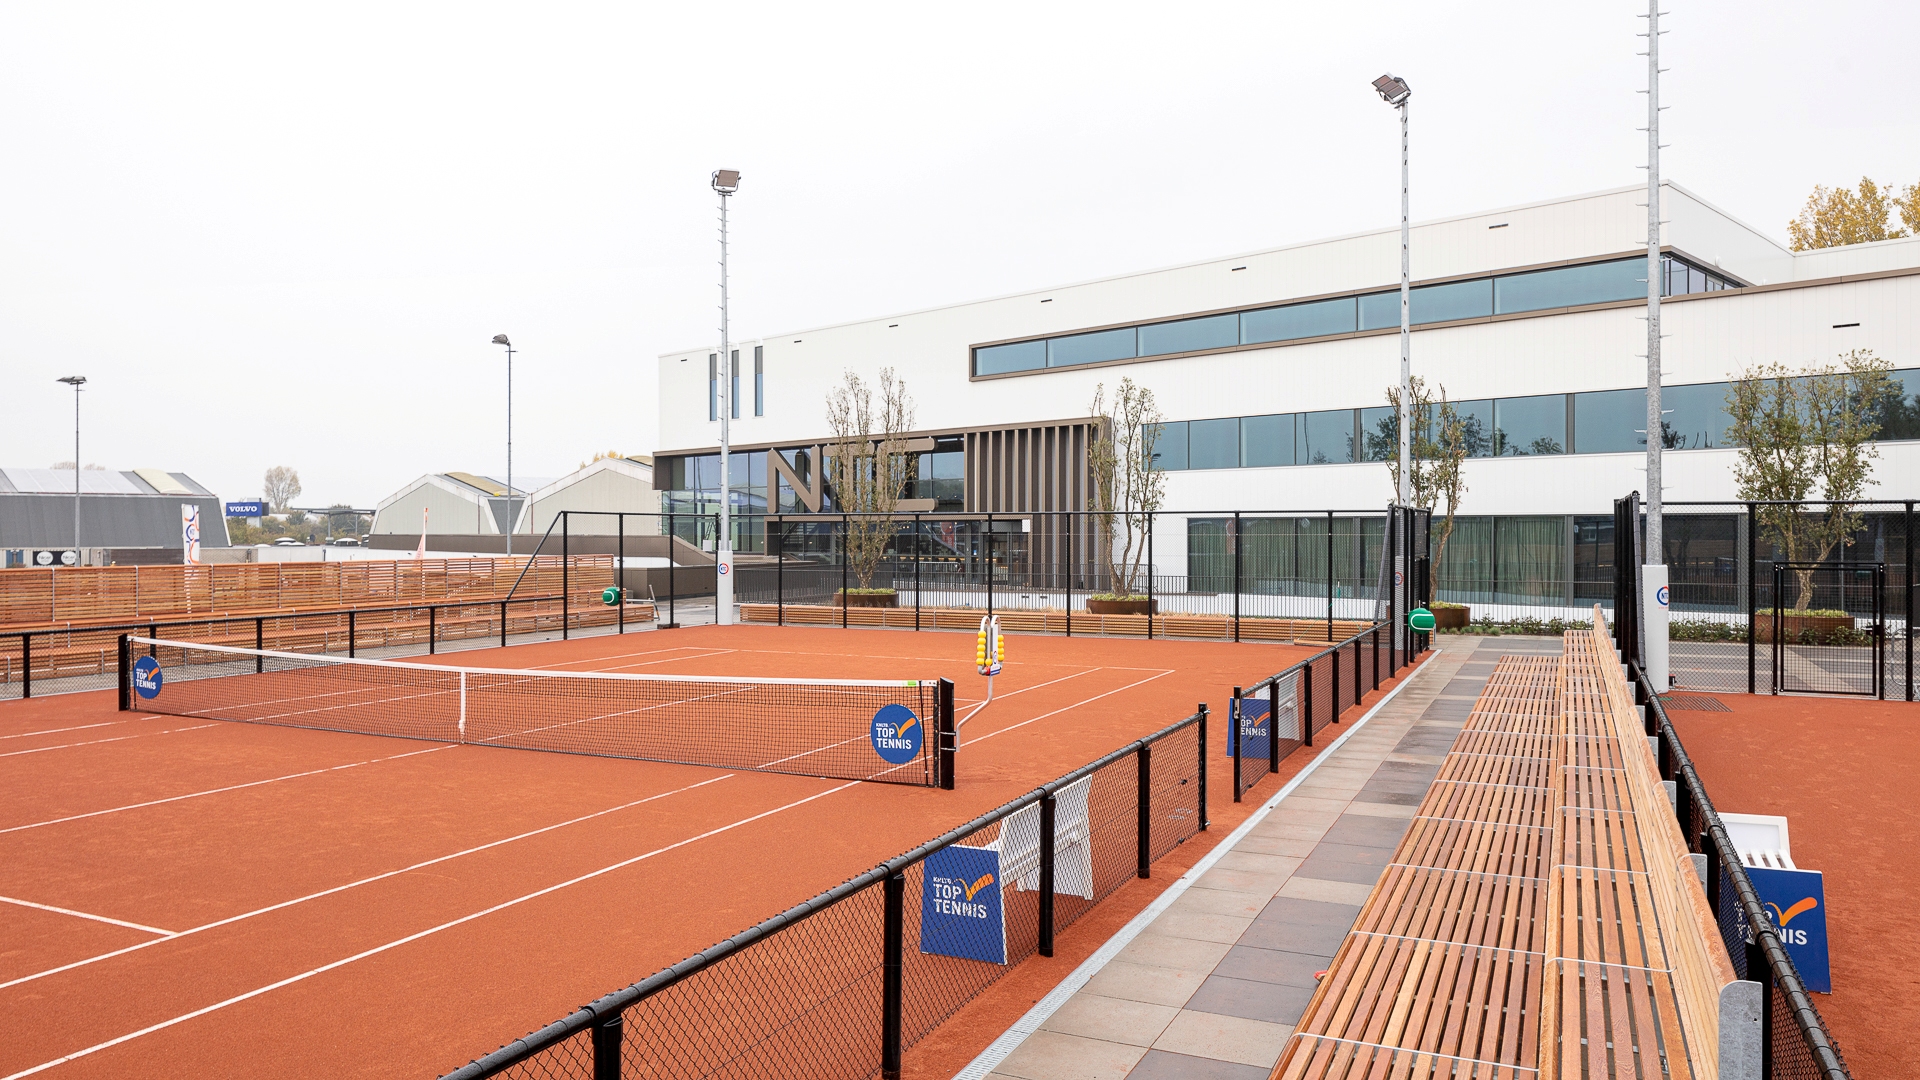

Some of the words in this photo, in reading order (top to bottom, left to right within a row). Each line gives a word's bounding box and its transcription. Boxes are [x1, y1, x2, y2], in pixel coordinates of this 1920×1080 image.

[766, 437, 936, 515] NTC
[136, 672, 147, 680] TOP
[136, 679, 156, 689] TENNIS
[1241, 719, 1251, 727] OP
[876, 727, 895, 738] TOP
[1241, 727, 1267, 736] ENNIS
[876, 738, 912, 749] TENNIS
[933, 883, 962, 899] TOP
[933, 899, 987, 918] TENNIS
